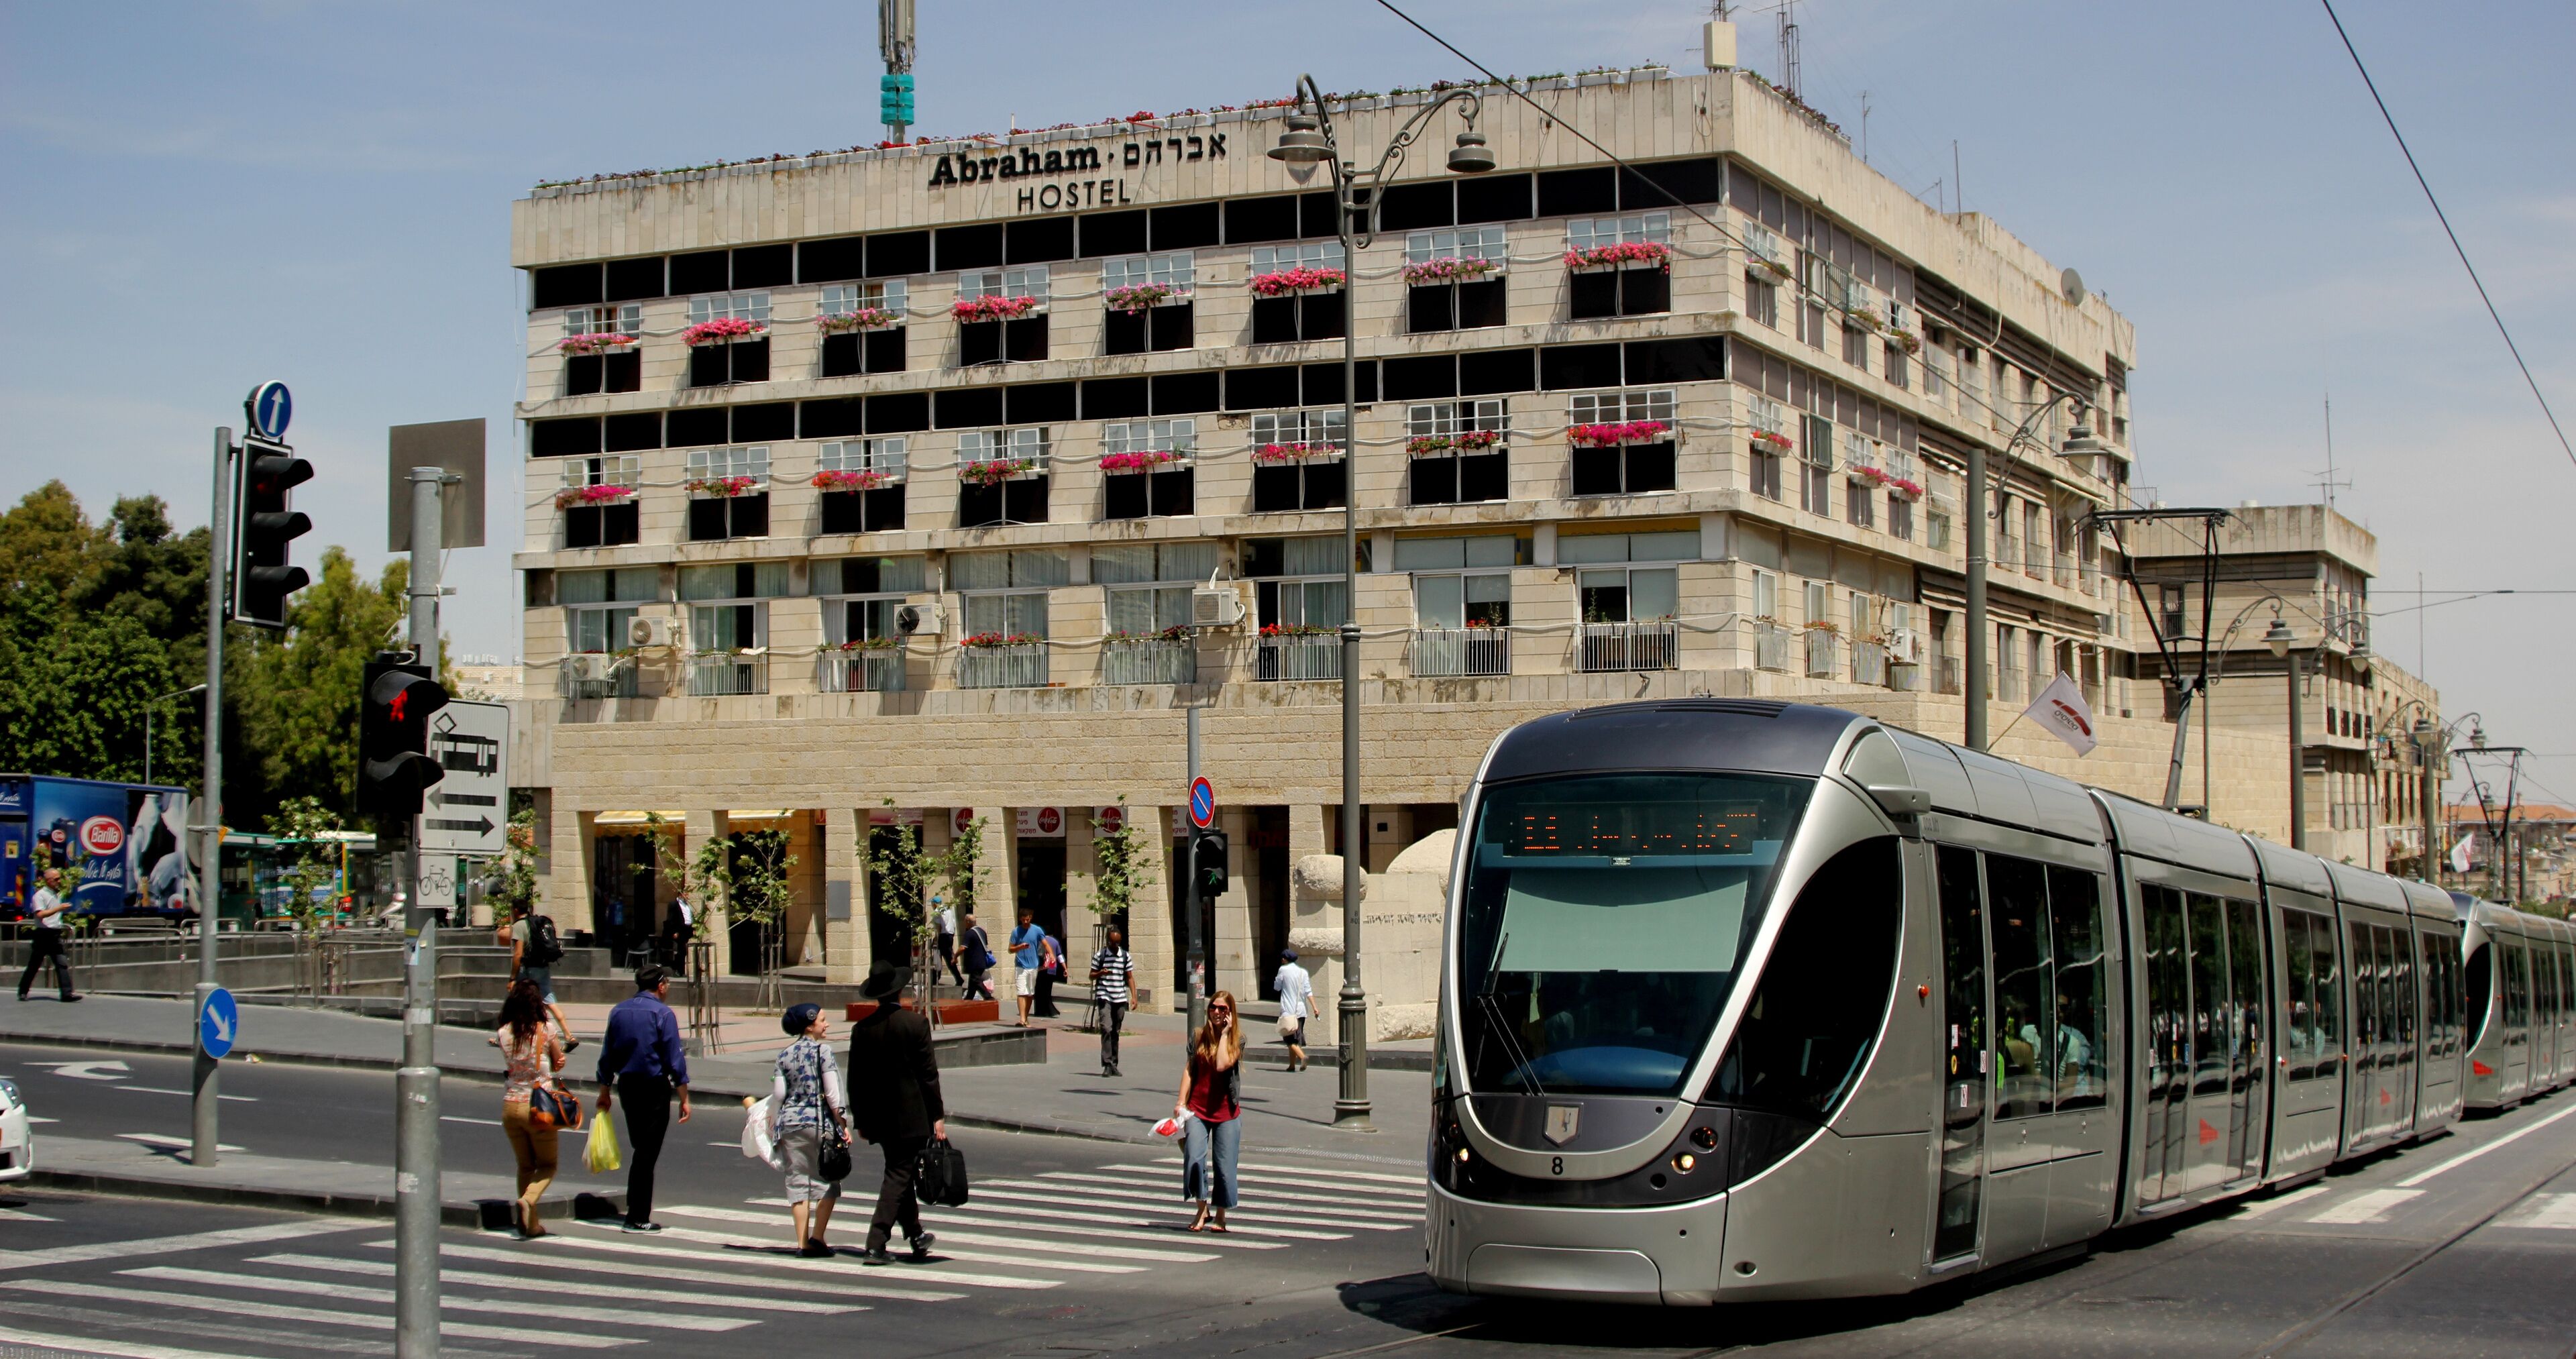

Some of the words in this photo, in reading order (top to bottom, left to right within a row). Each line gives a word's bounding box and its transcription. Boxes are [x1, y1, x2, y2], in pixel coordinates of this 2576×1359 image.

[929, 146, 1101, 186] Abraham
[1123, 132, 1226, 166] אברהם
[1018, 178, 1130, 212] HOSTEL
[91, 826, 119, 844] Barilla
[1551, 1156, 1564, 1176] 8
